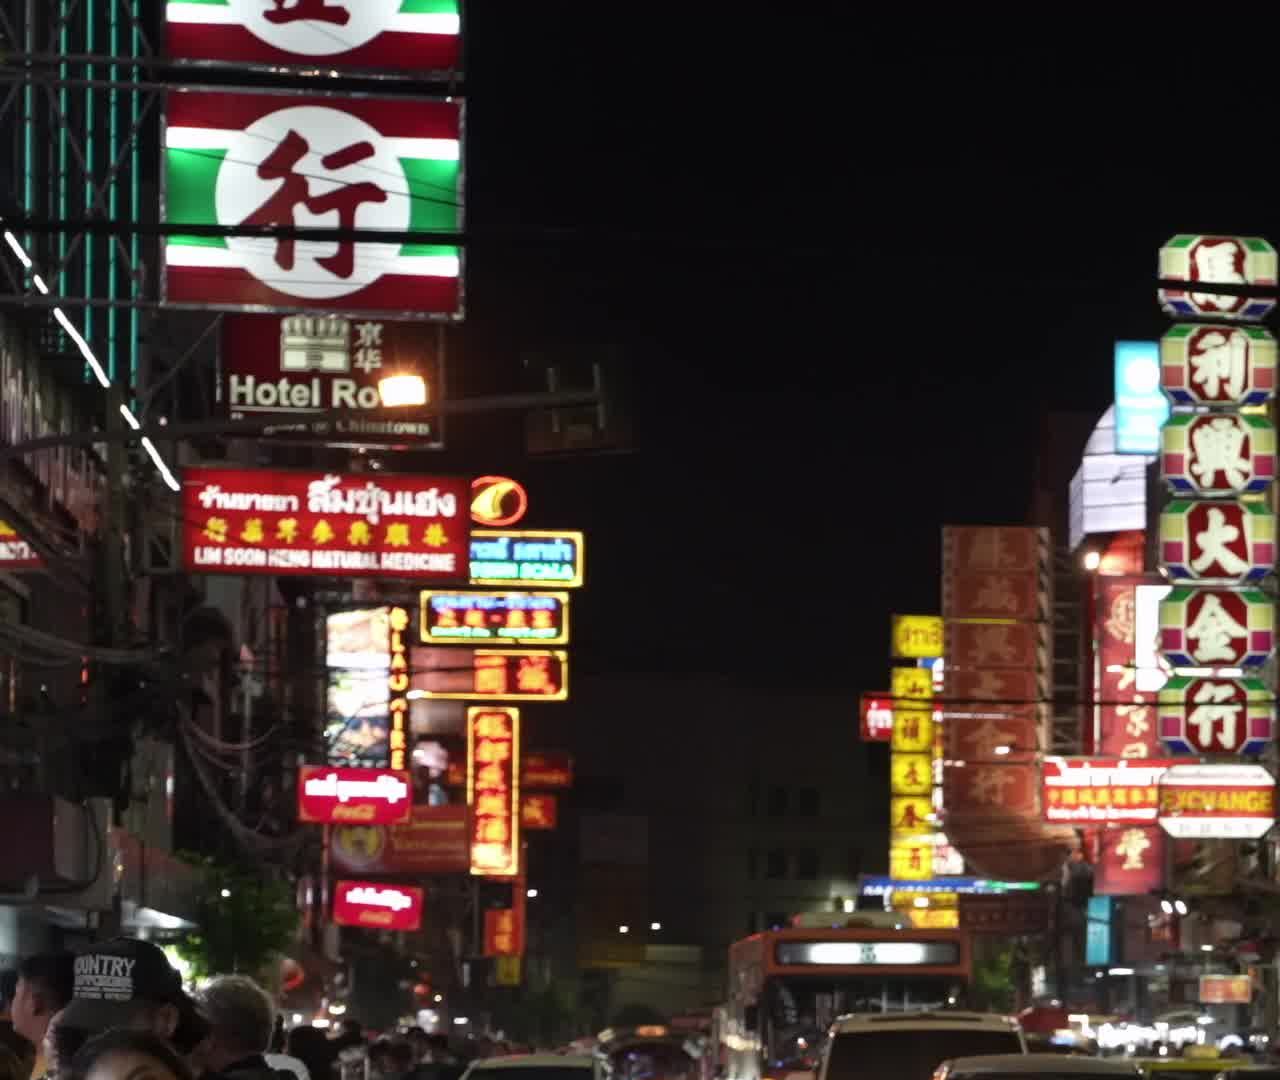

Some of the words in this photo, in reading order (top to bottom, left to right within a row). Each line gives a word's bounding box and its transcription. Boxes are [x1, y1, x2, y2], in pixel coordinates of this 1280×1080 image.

[236, 128, 388, 278] 行
[229, 374, 320, 408] Hotel
[336, 419, 429, 435] Chinatown
[194, 546, 222, 564] LIM
[223, 547, 266, 566] SOON
[311, 550, 379, 570] NATURAL
[380, 552, 457, 572] MEDICINE
[1161, 790, 1272, 813] EXCHANGE
